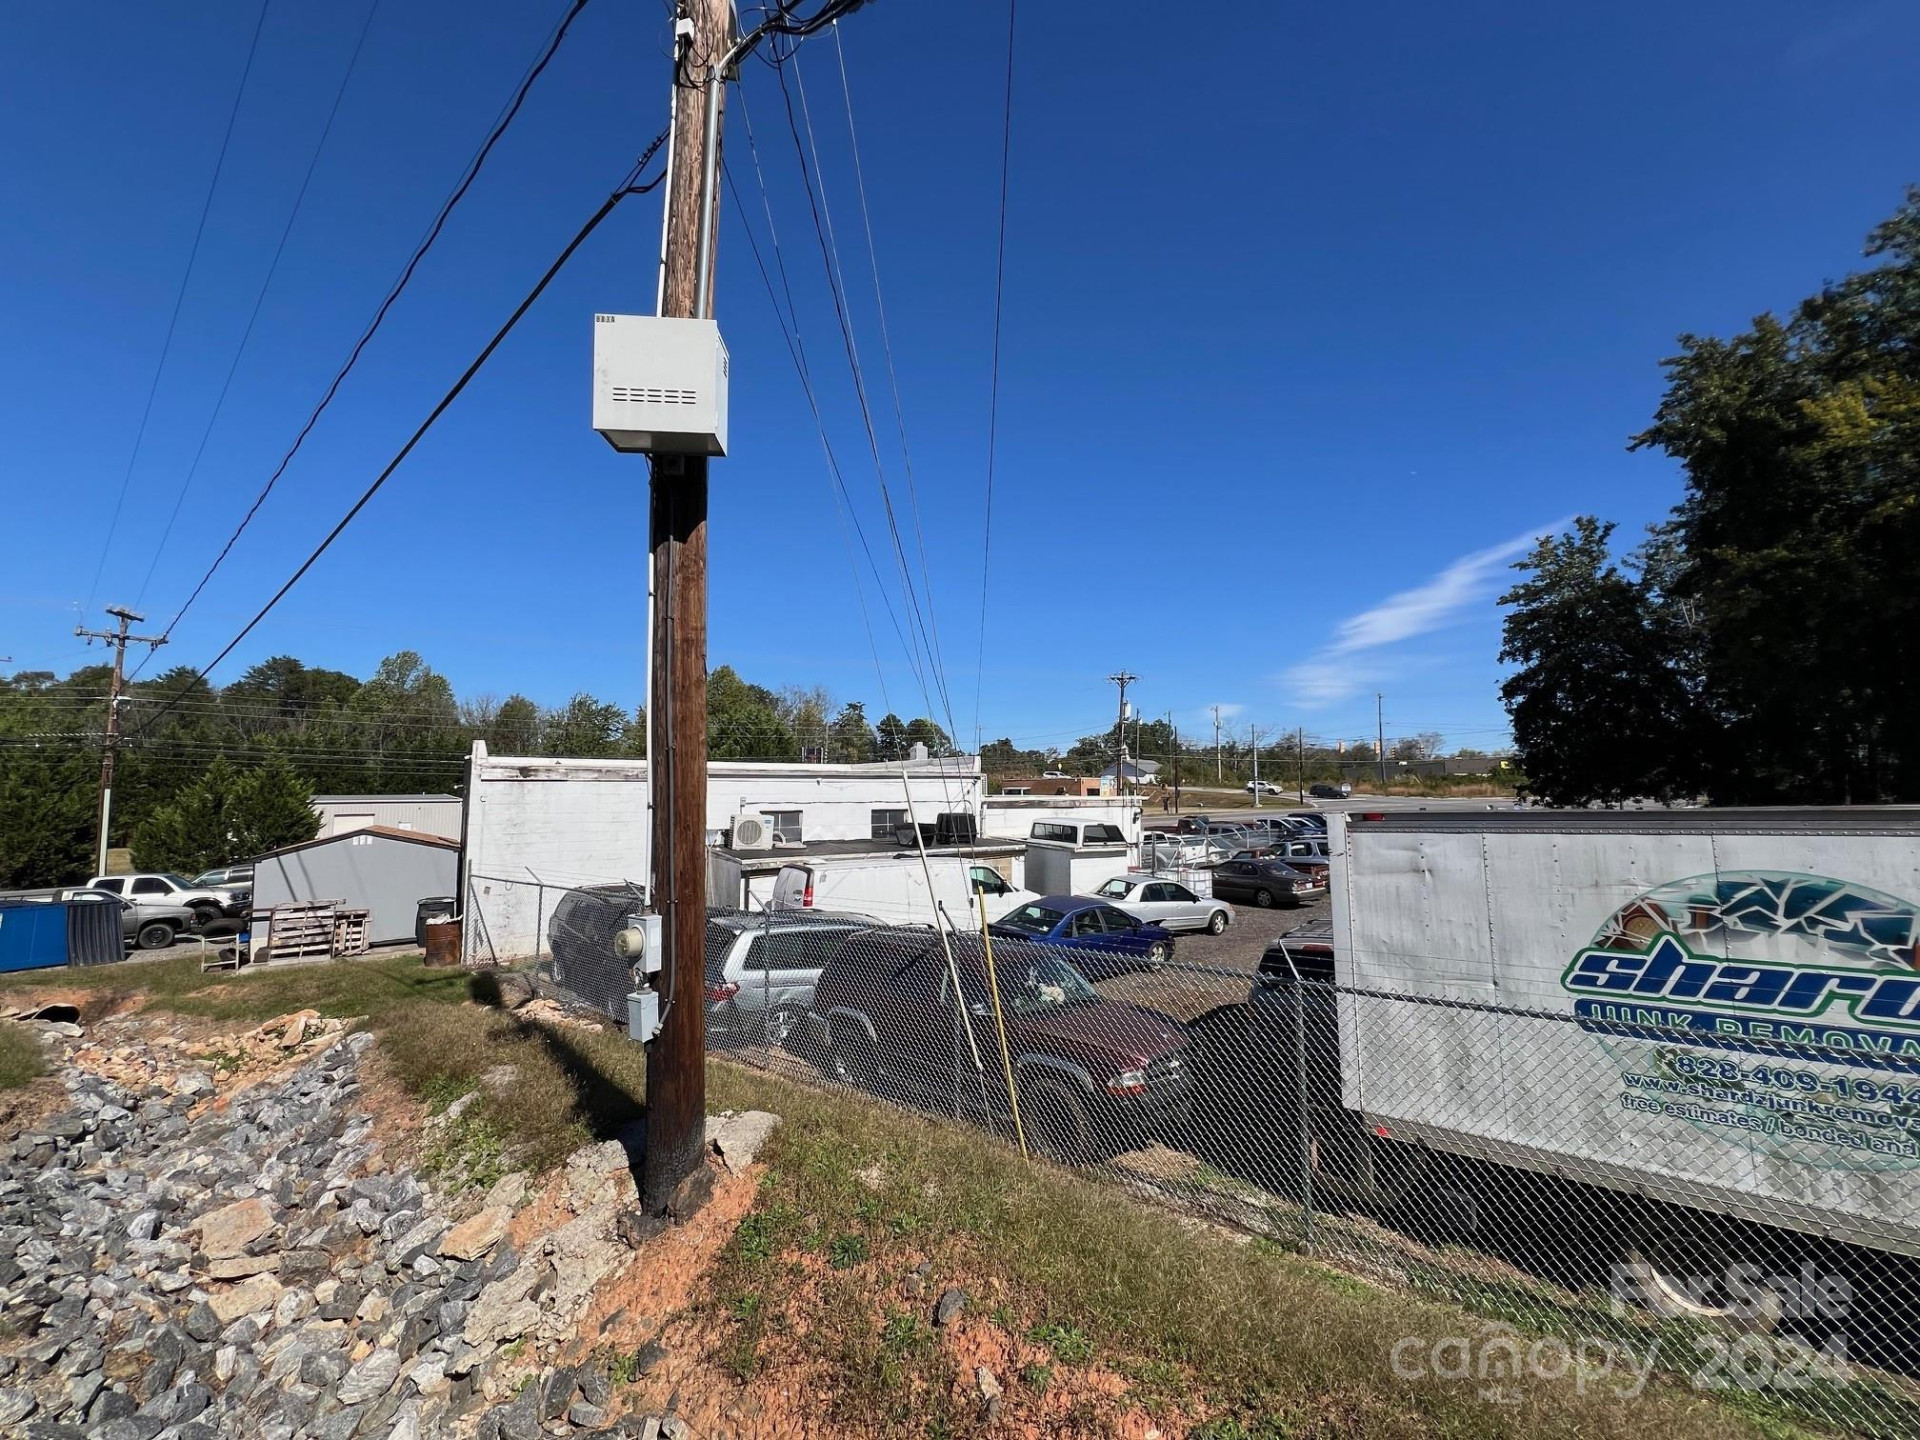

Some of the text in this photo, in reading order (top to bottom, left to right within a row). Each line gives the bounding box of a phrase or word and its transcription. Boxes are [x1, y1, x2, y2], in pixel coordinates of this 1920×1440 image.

[1621, 1093, 1661, 1113] free
[1664, 1103, 1762, 1131] estimates
[1780, 1120, 1866, 1148] bonded
[1871, 1136, 1919, 1158] and
